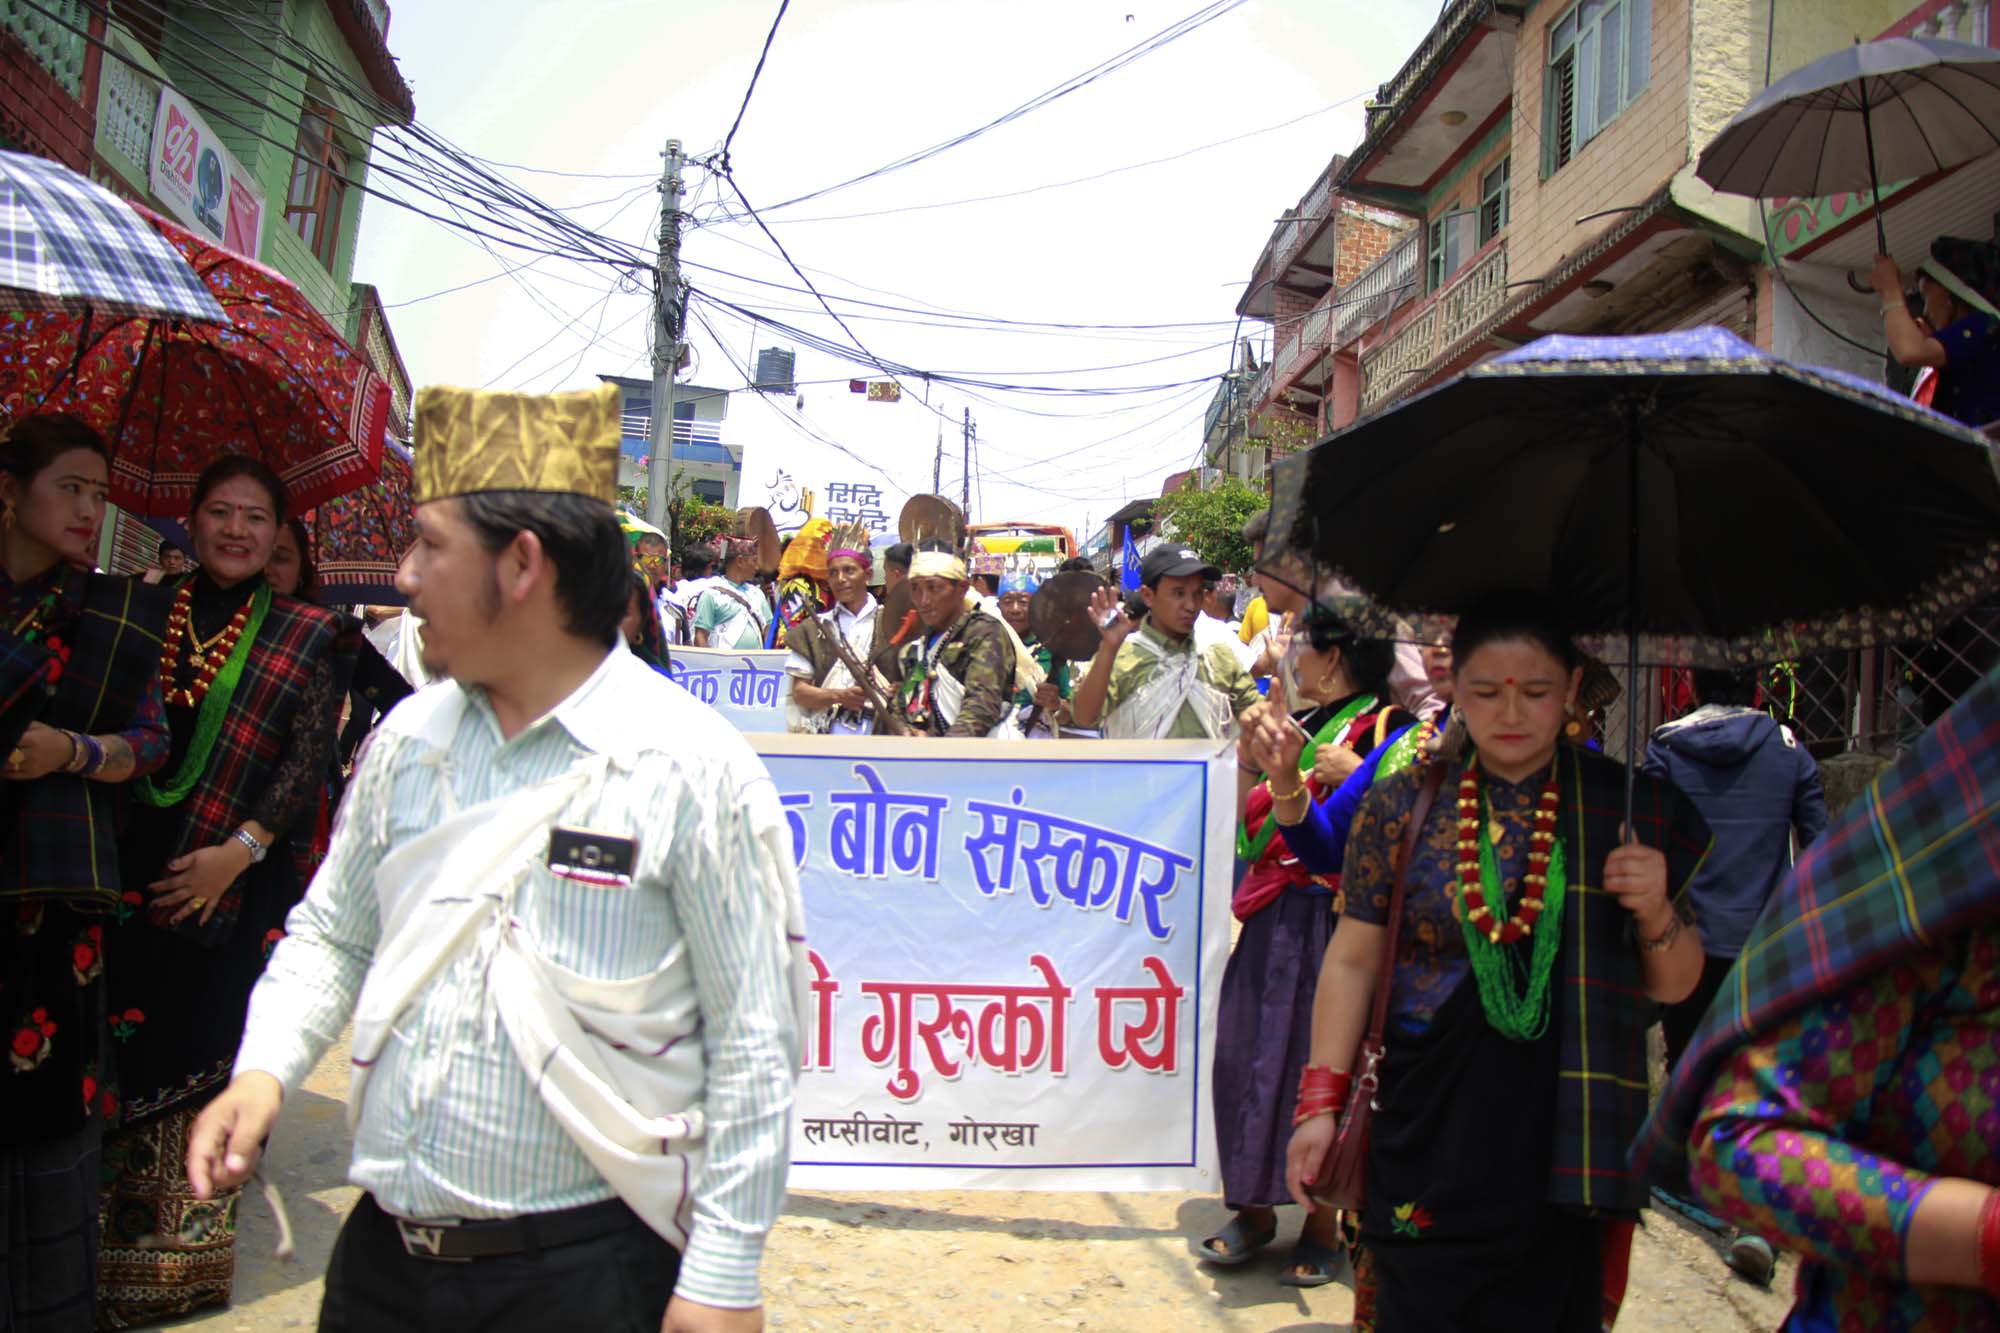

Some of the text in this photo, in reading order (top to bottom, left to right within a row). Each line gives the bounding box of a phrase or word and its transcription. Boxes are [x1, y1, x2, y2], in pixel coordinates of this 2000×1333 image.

[731, 657, 784, 708] बोन
[829, 763, 947, 879] बोन
[964, 787, 1193, 940] संस्कार
[948, 1115, 1040, 1151] गोरखा
